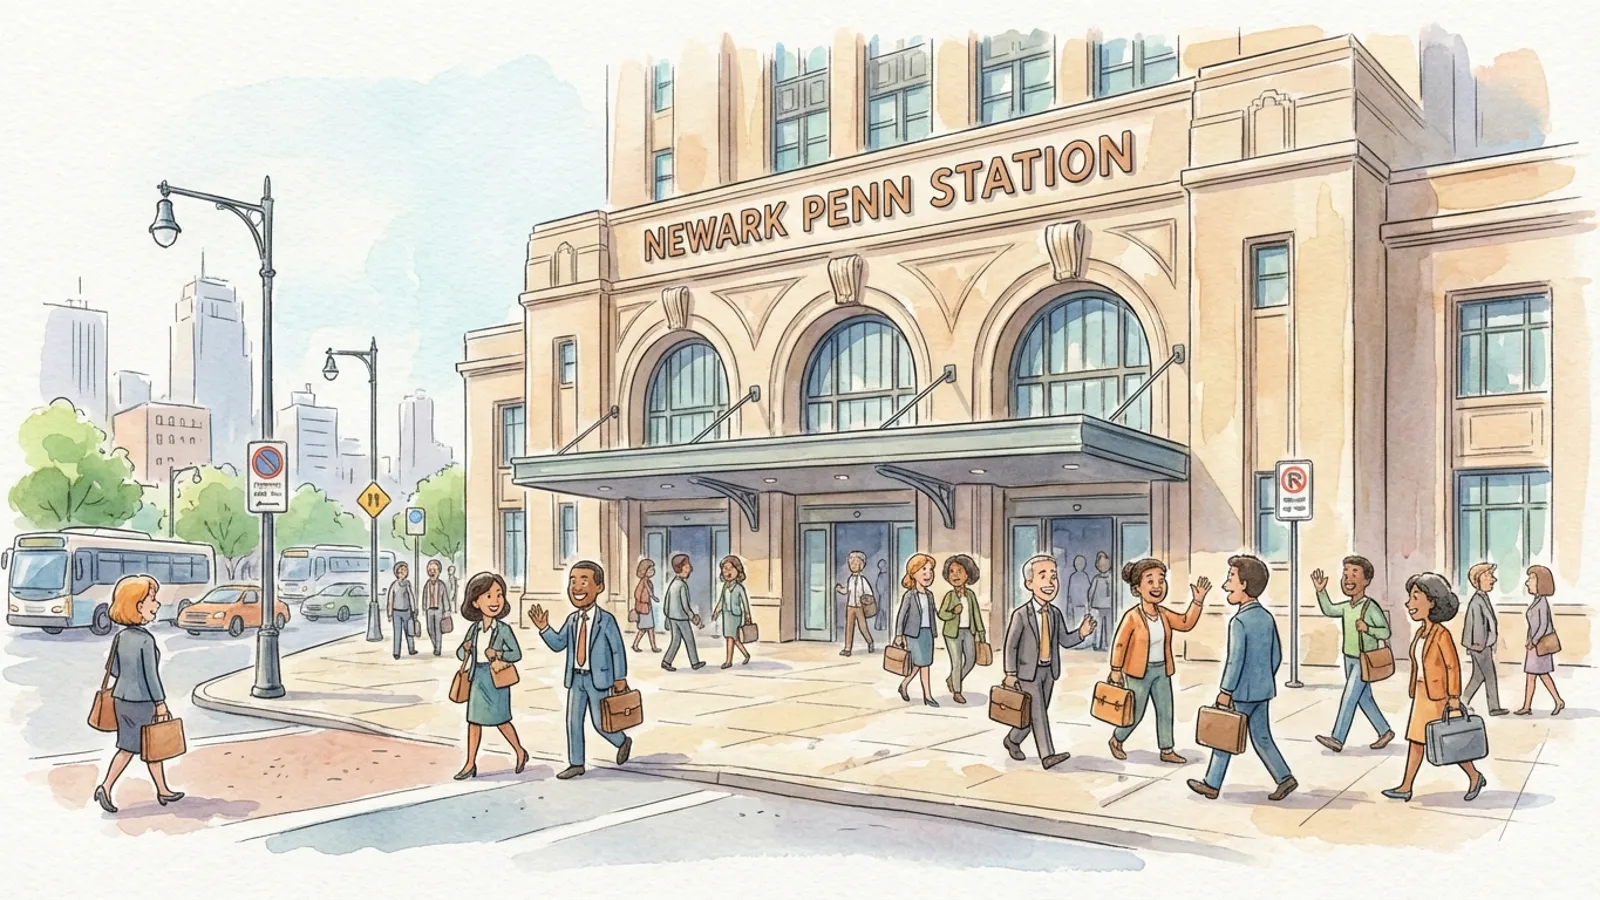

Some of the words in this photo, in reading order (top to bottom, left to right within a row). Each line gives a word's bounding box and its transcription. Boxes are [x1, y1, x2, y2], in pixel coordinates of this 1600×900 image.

[644, 200, 789, 262] NEWARK
[802, 175, 912, 233] PENN
[930, 129, 1135, 208] STATION
